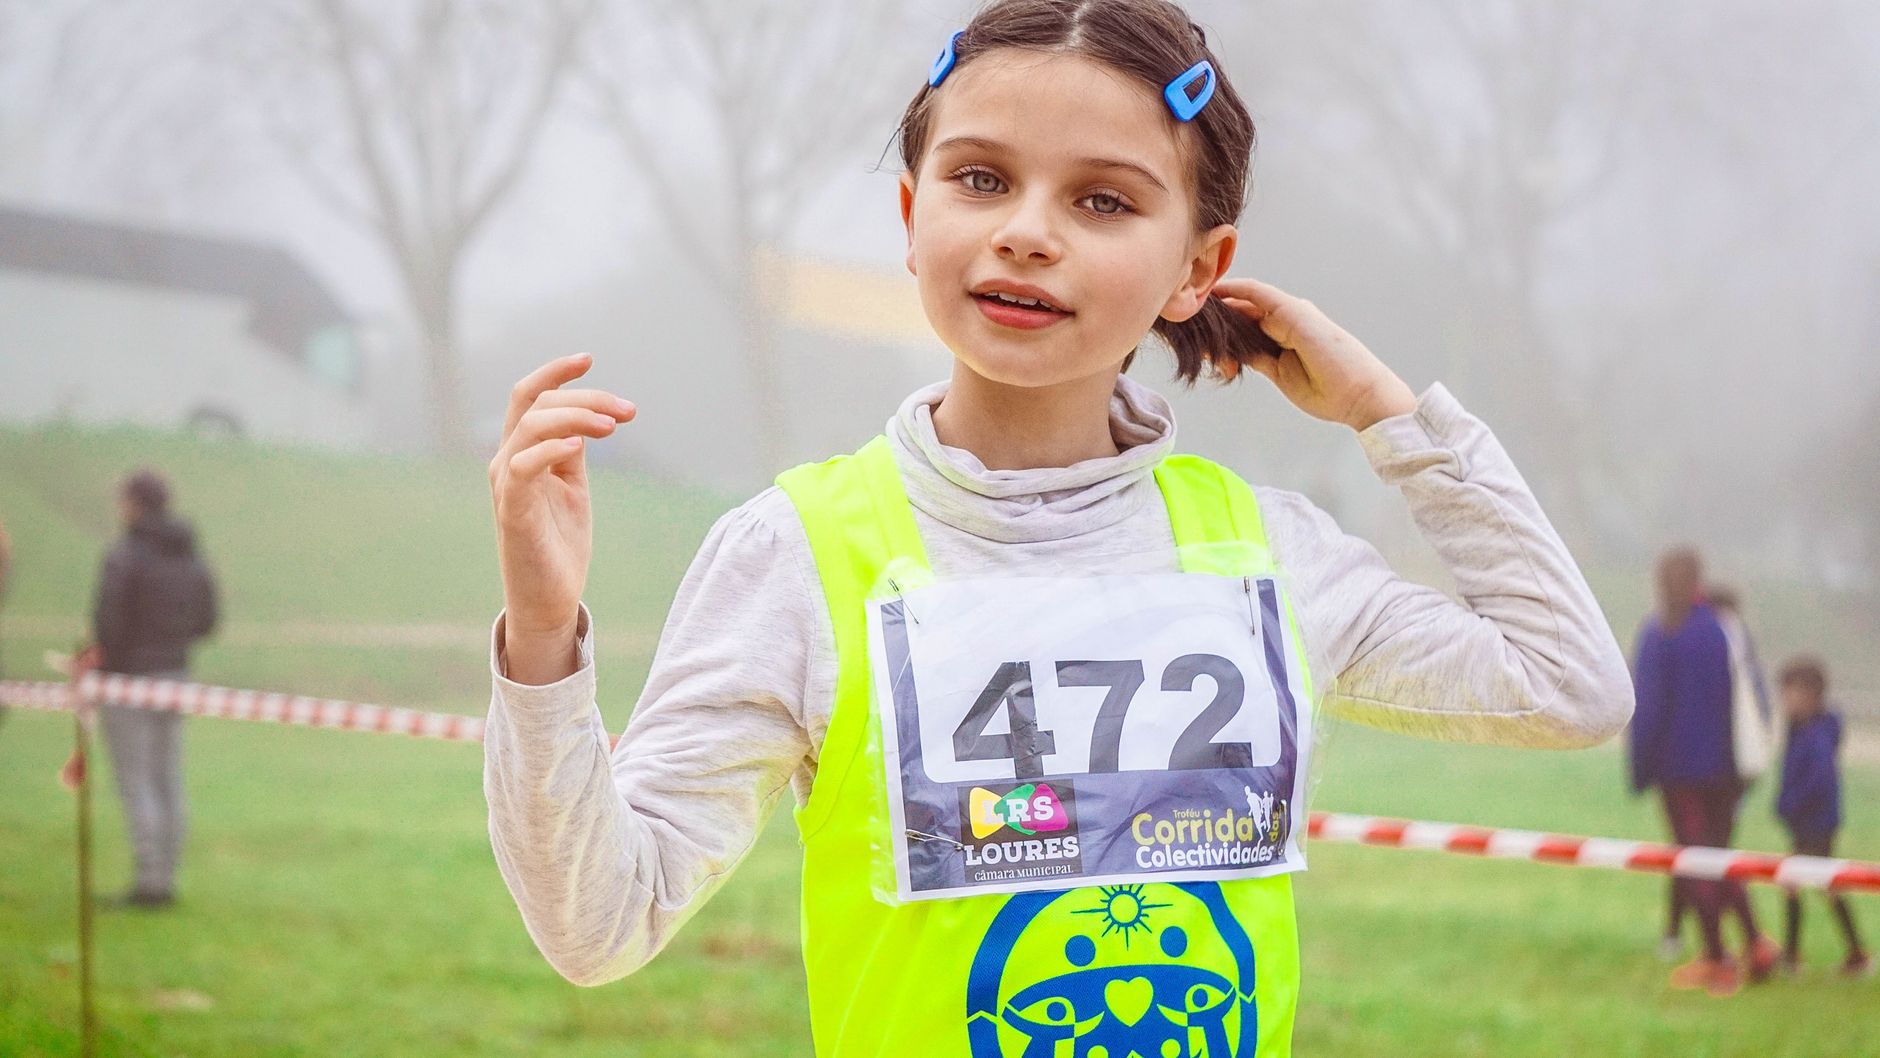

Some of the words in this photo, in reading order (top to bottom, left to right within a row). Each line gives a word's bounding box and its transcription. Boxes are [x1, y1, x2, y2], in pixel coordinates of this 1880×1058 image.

[952, 653, 1253, 779] 472
[983, 796, 1054, 824] LRS
[1173, 808, 1200, 819] Troféu
[1132, 808, 1253, 846] Corrida
[964, 836, 1080, 866] LOURES
[1136, 841, 1273, 868] Colectividades
